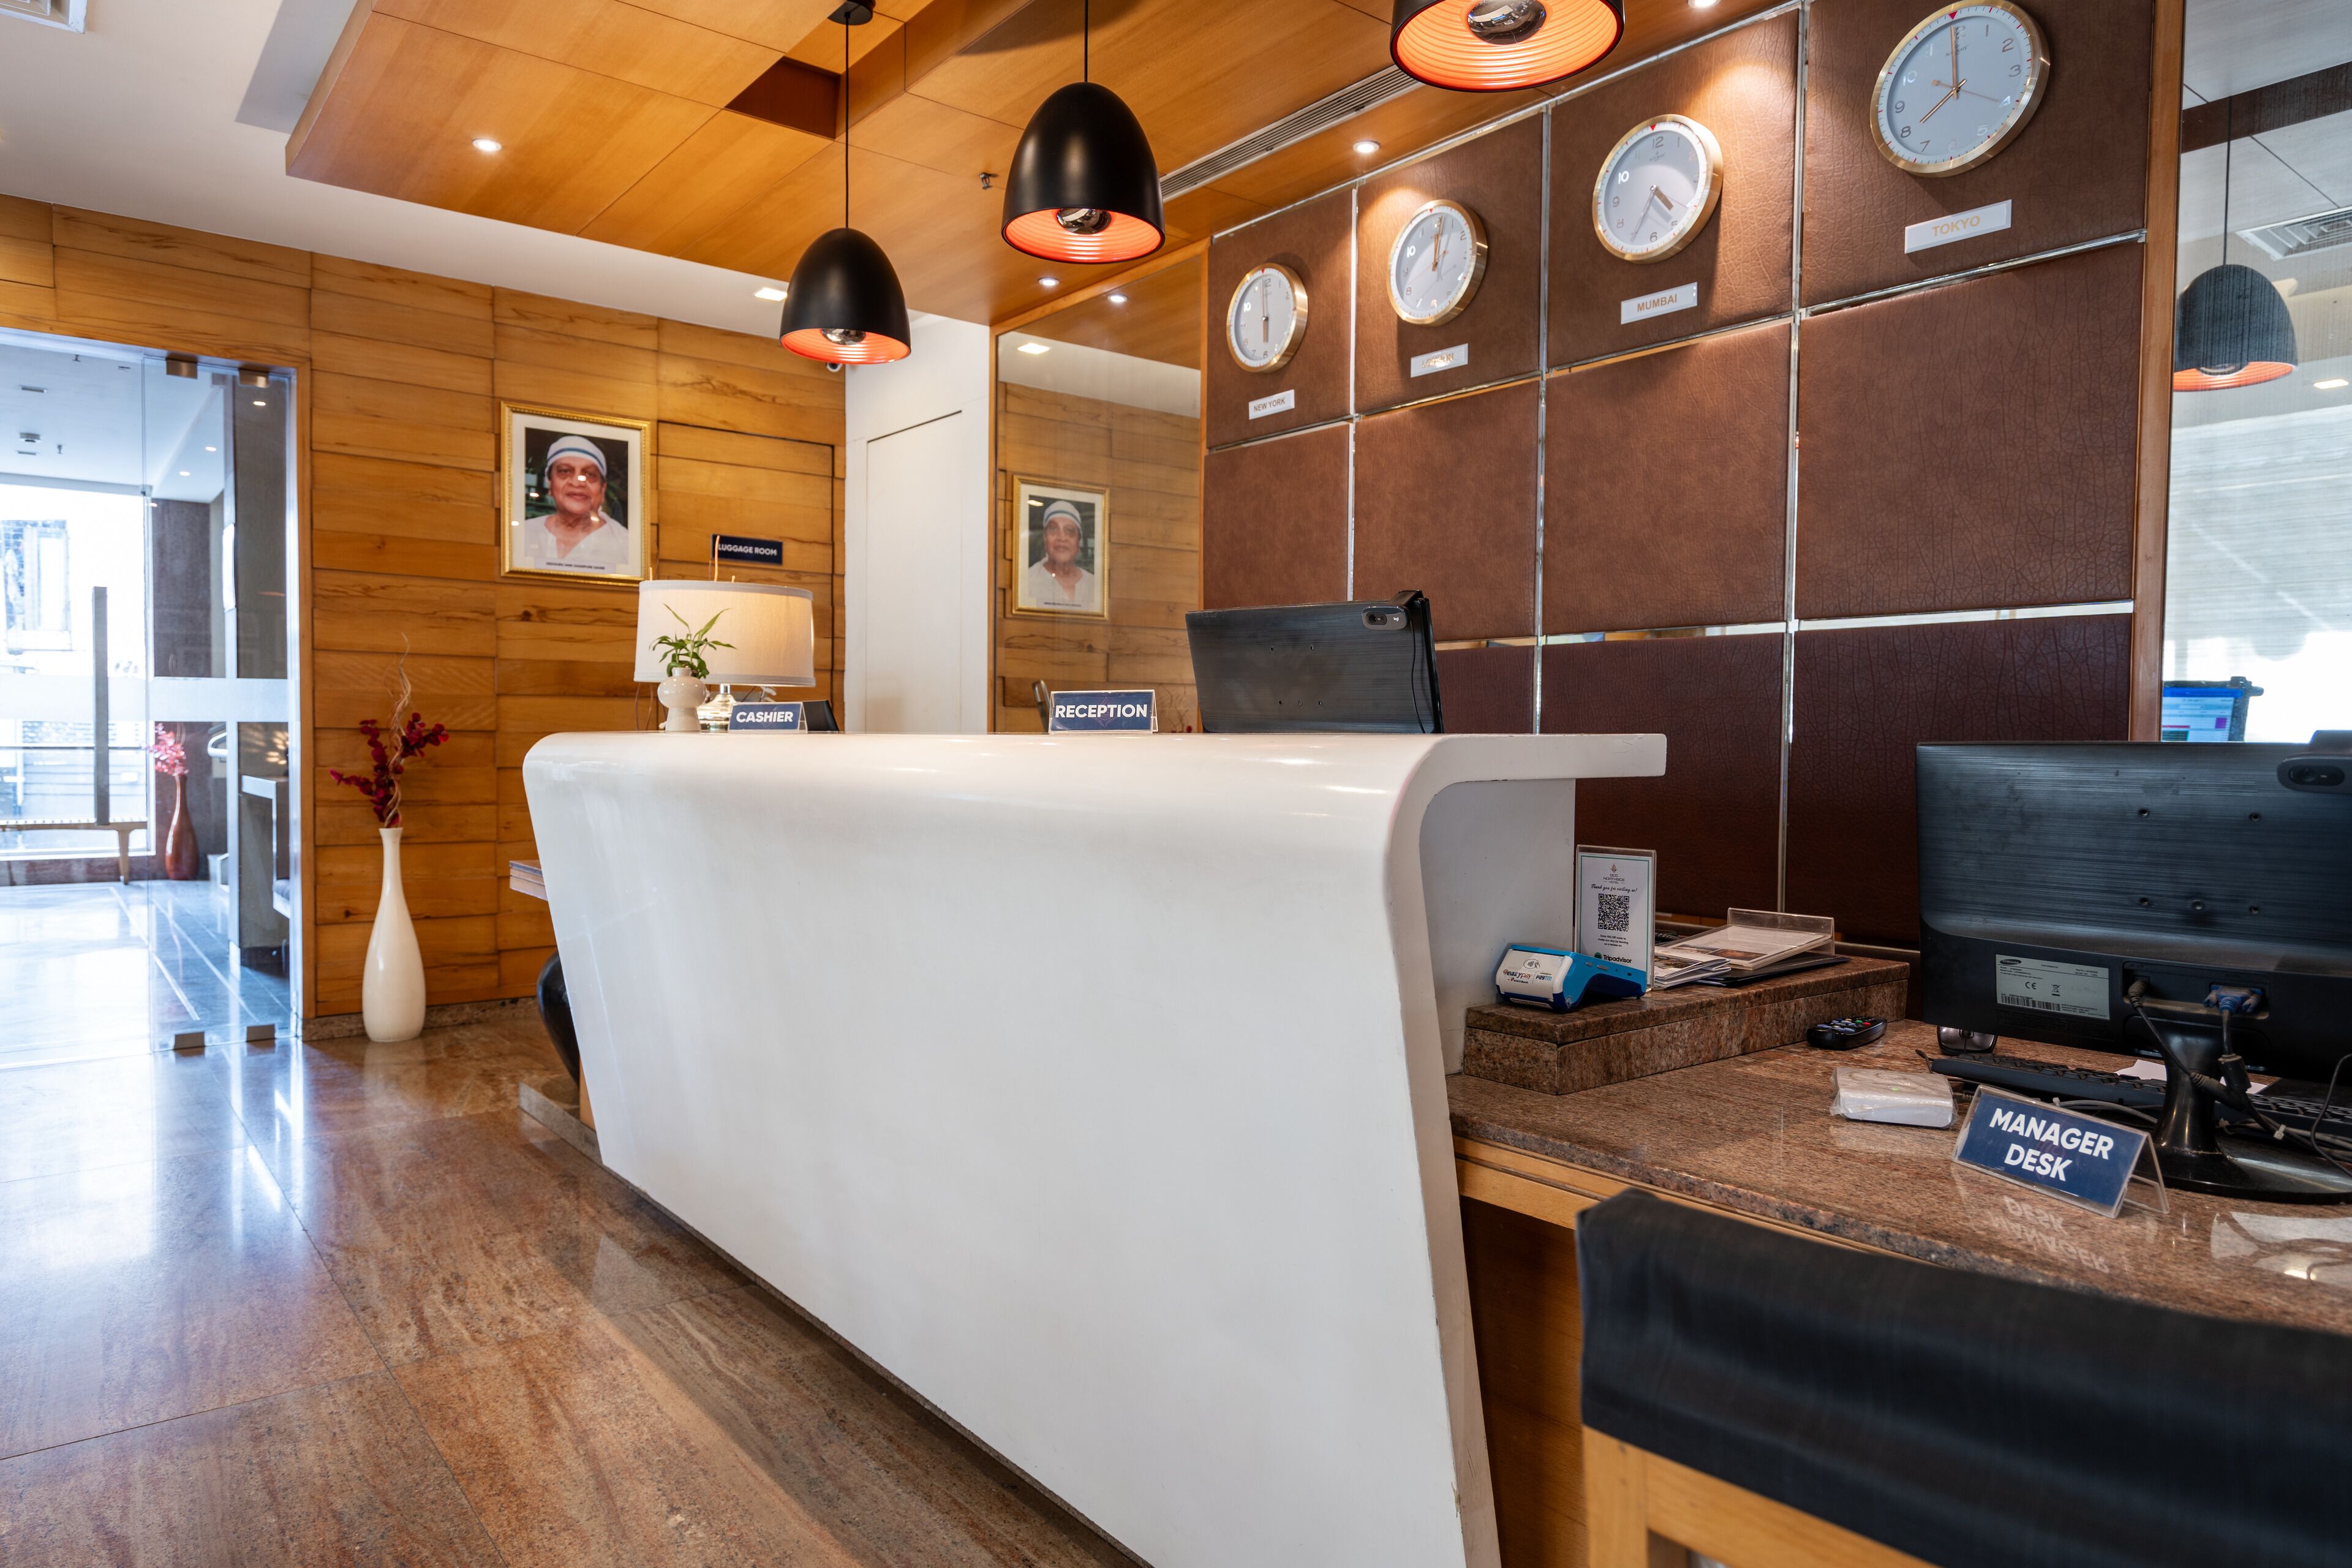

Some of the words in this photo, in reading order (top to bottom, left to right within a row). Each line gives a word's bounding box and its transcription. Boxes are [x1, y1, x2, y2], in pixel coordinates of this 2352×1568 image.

[2002, 37, 2015, 53] 2
[2008, 64, 2021, 78] 3
[1902, 70, 1918, 86] 10
[1895, 100, 1905, 114] 9
[1900, 126, 1912, 138] 8
[1977, 124, 1988, 137] 5
[1652, 136, 1664, 149] 12
[1920, 140, 1931, 153] 7
[1618, 170, 1630, 184] 10
[1612, 196, 1621, 208] 9
[1932, 216, 1981, 236] TOKYO
[1649, 232, 1658, 243] 6
[1407, 246, 1416, 257] 10
[1243, 302, 1251, 312] 10
[1637, 294, 1678, 312] MUMBAI
[1254, 402, 1267, 412] NEW
[1268, 397, 1286, 408] YORK
[718, 544, 753, 554] LUGGAGE
[736, 711, 794, 722] CASHIER
[1055, 704, 1147, 717] RECEPTION
[1603, 954, 1632, 963] Tripadvisor
[1507, 970, 1532, 979] eazypay
[1989, 1108, 2114, 1159] MANAGER
[2004, 1144, 2073, 1182] DESK
